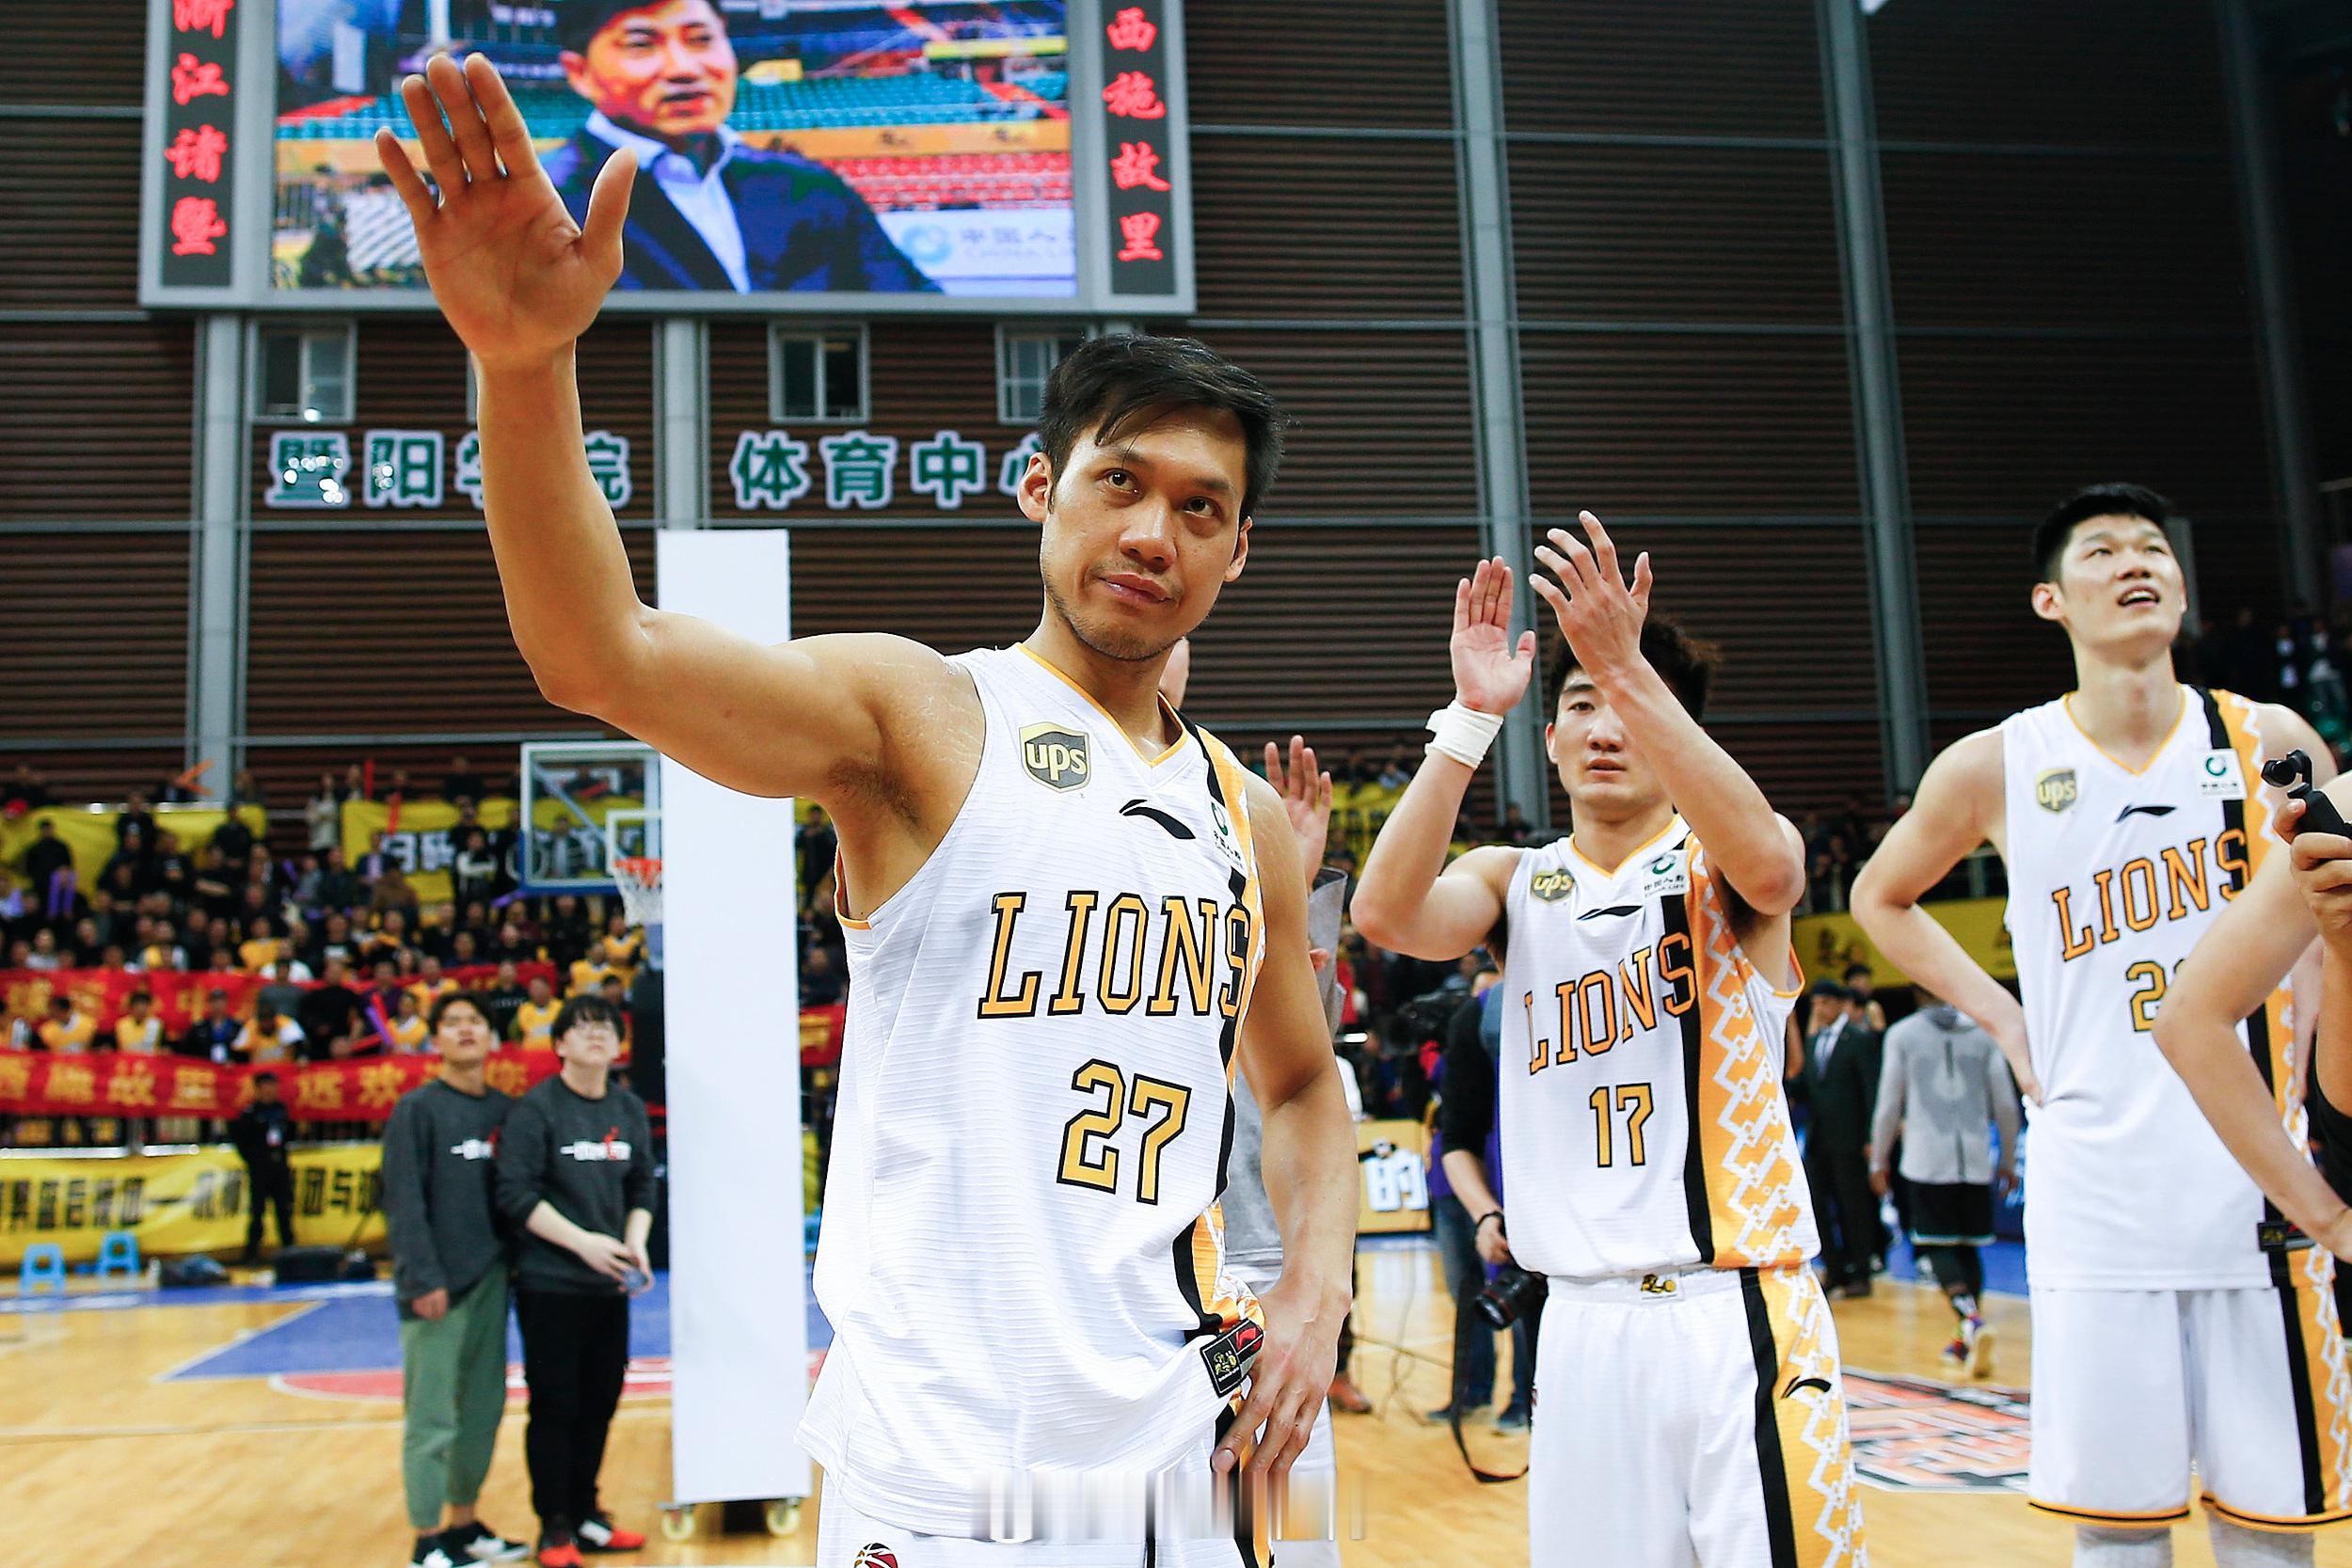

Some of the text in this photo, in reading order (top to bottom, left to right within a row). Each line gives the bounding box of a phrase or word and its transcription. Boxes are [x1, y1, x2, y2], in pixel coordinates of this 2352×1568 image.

[1103, 8, 1171, 261] 西施故里
[1026, 742, 1088, 782] ups
[2037, 778, 2076, 810] ups
[1532, 873, 1575, 898] ups
[2051, 828, 2251, 961] LIONS
[977, 890, 1251, 1021] LIONS
[1524, 931, 1697, 1076] LIONS
[2125, 957, 2188, 1033] 2
[1057, 1057, 1192, 1206] 27
[1589, 1082, 1655, 1168] 17
